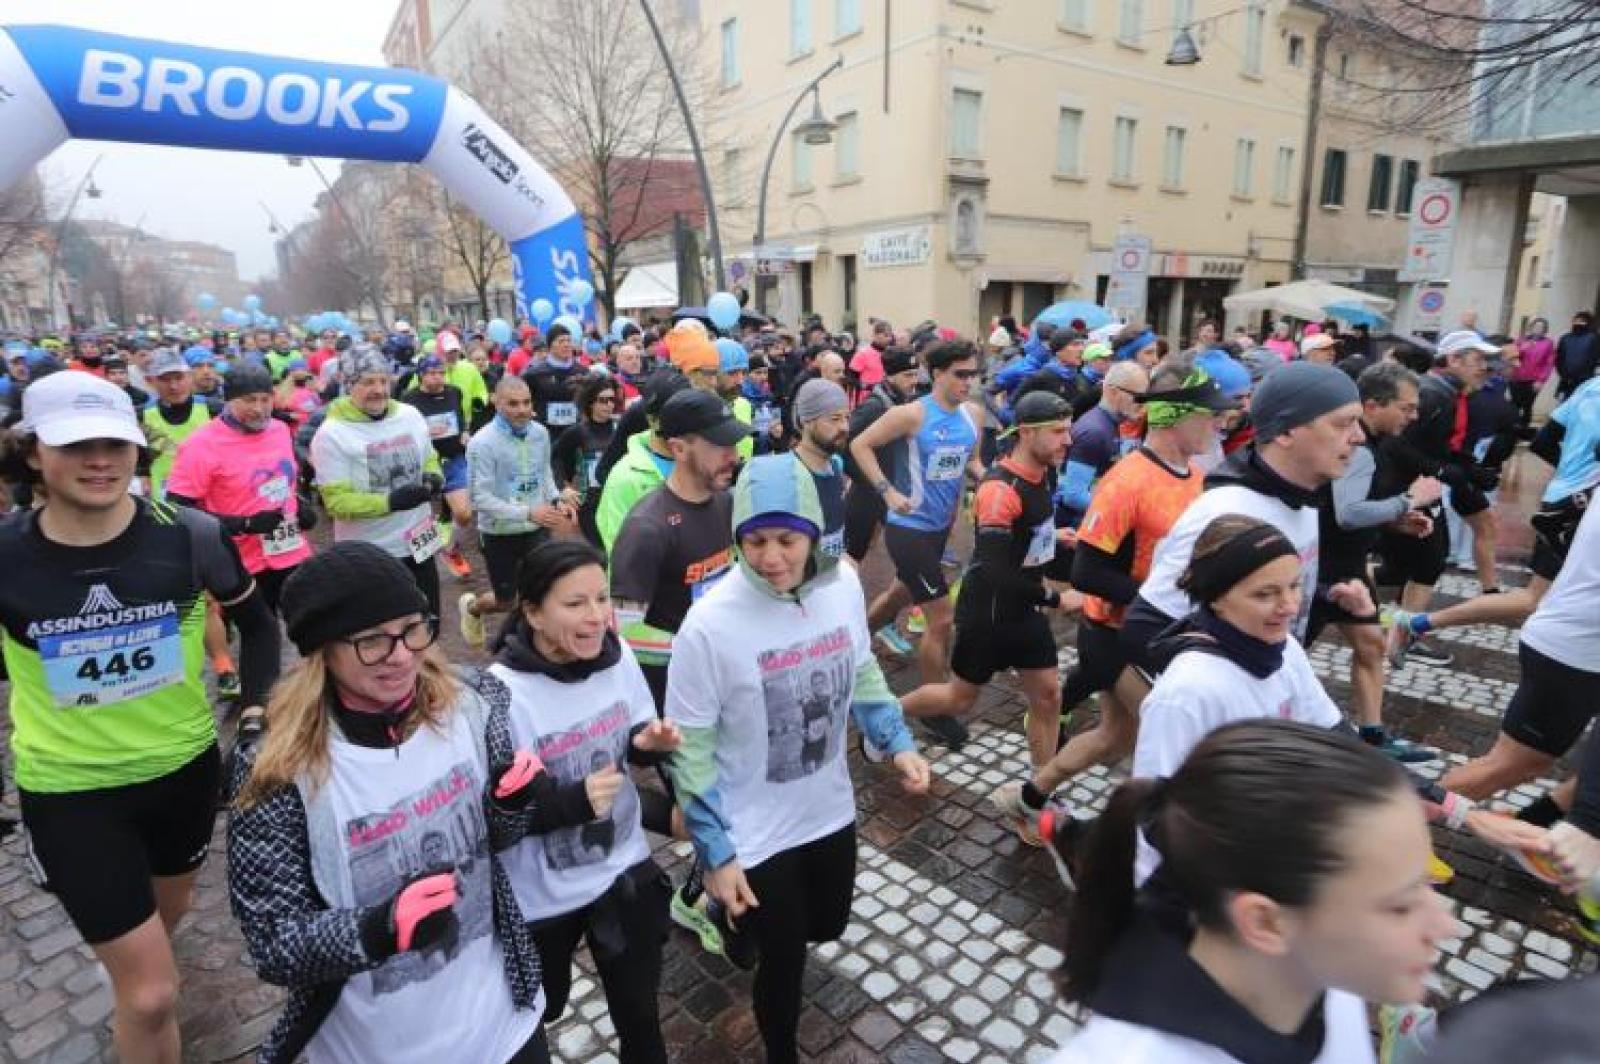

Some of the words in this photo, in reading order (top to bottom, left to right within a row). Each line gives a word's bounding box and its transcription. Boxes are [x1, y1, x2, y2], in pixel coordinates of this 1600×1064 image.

[78, 49, 413, 132] BROOKS
[26, 600, 177, 638] ASSINDUSTRIA
[77, 646, 155, 681] 446
